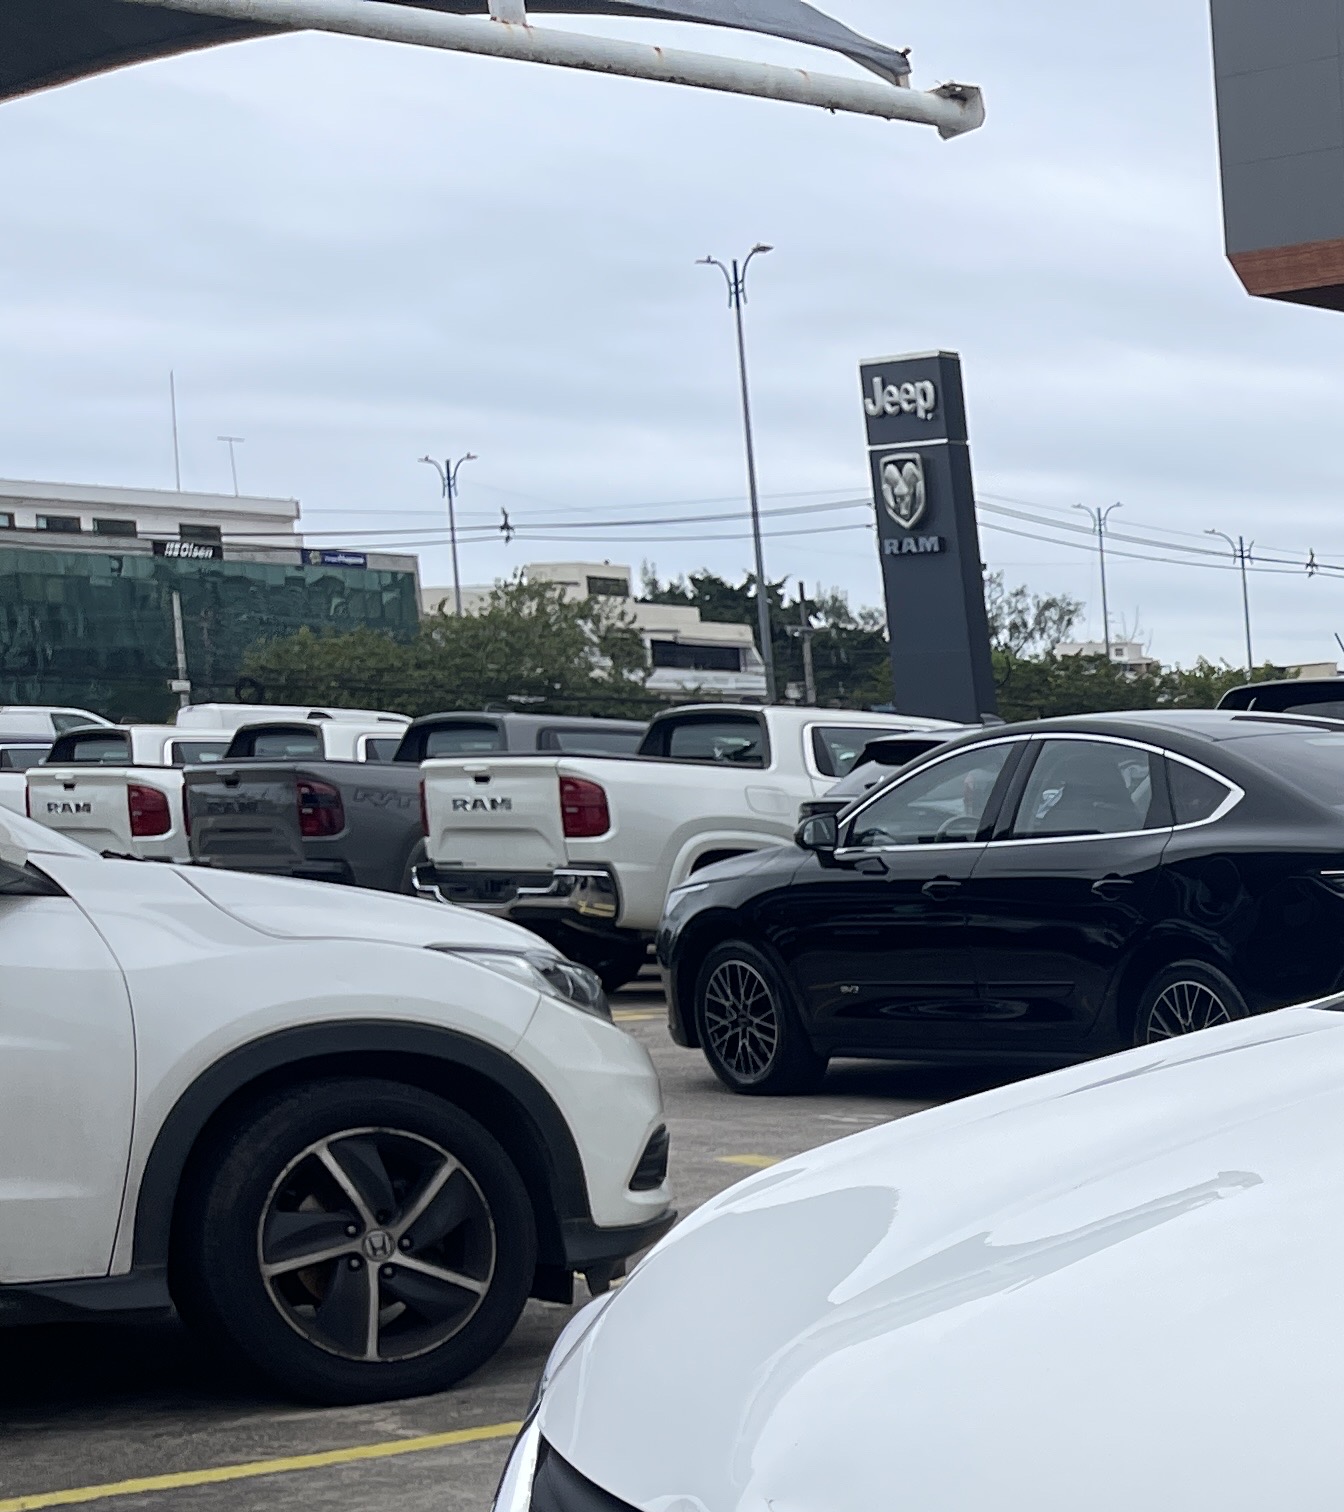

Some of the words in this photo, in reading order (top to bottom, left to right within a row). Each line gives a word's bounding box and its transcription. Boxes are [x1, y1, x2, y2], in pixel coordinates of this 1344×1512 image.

[864, 376, 935, 421] Jeep
[883, 536, 940, 555] RAM
[47, 802, 91, 814] RAM
[452, 798, 512, 812] RAM
